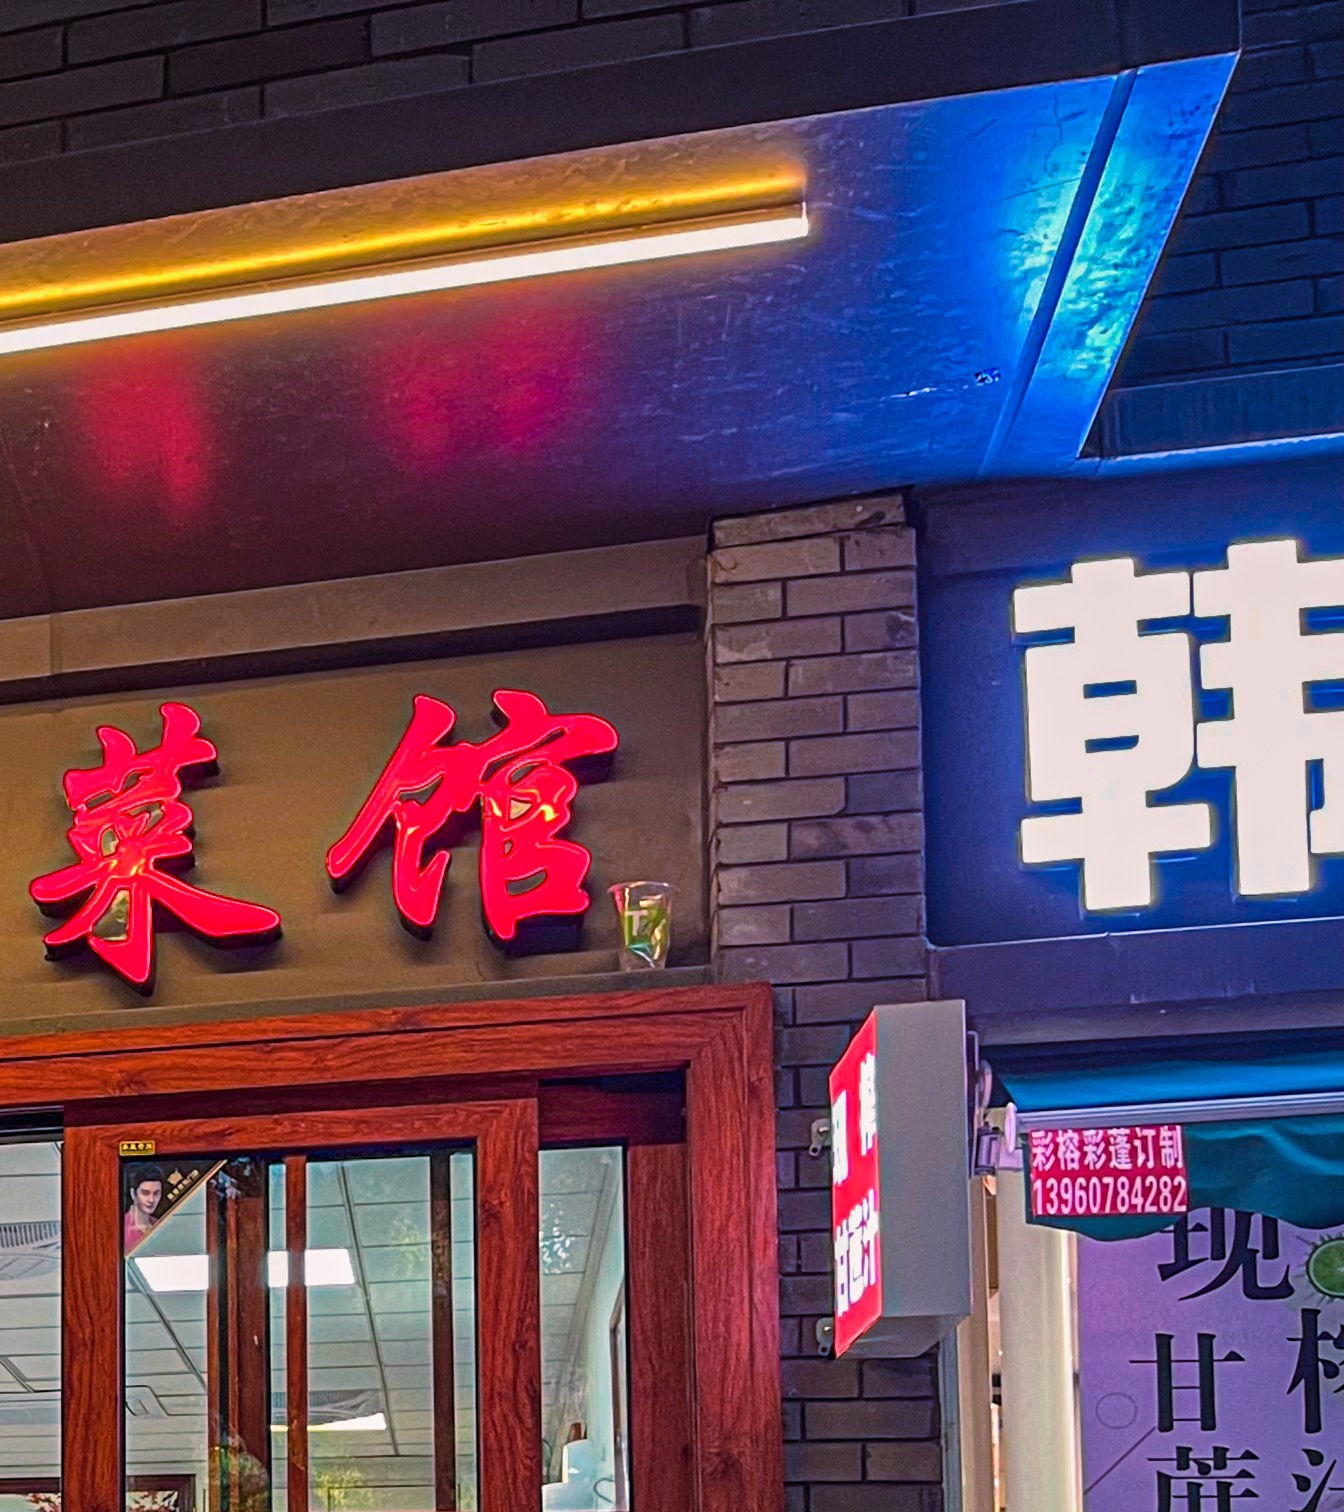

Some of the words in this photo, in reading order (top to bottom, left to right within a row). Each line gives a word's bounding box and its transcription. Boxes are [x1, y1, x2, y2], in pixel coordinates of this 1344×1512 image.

[1013, 540, 1344, 911] 韩
[1031, 1125, 1183, 1172] 彩榕彩蓬订制
[1033, 1175, 1187, 1214] 13960784282
